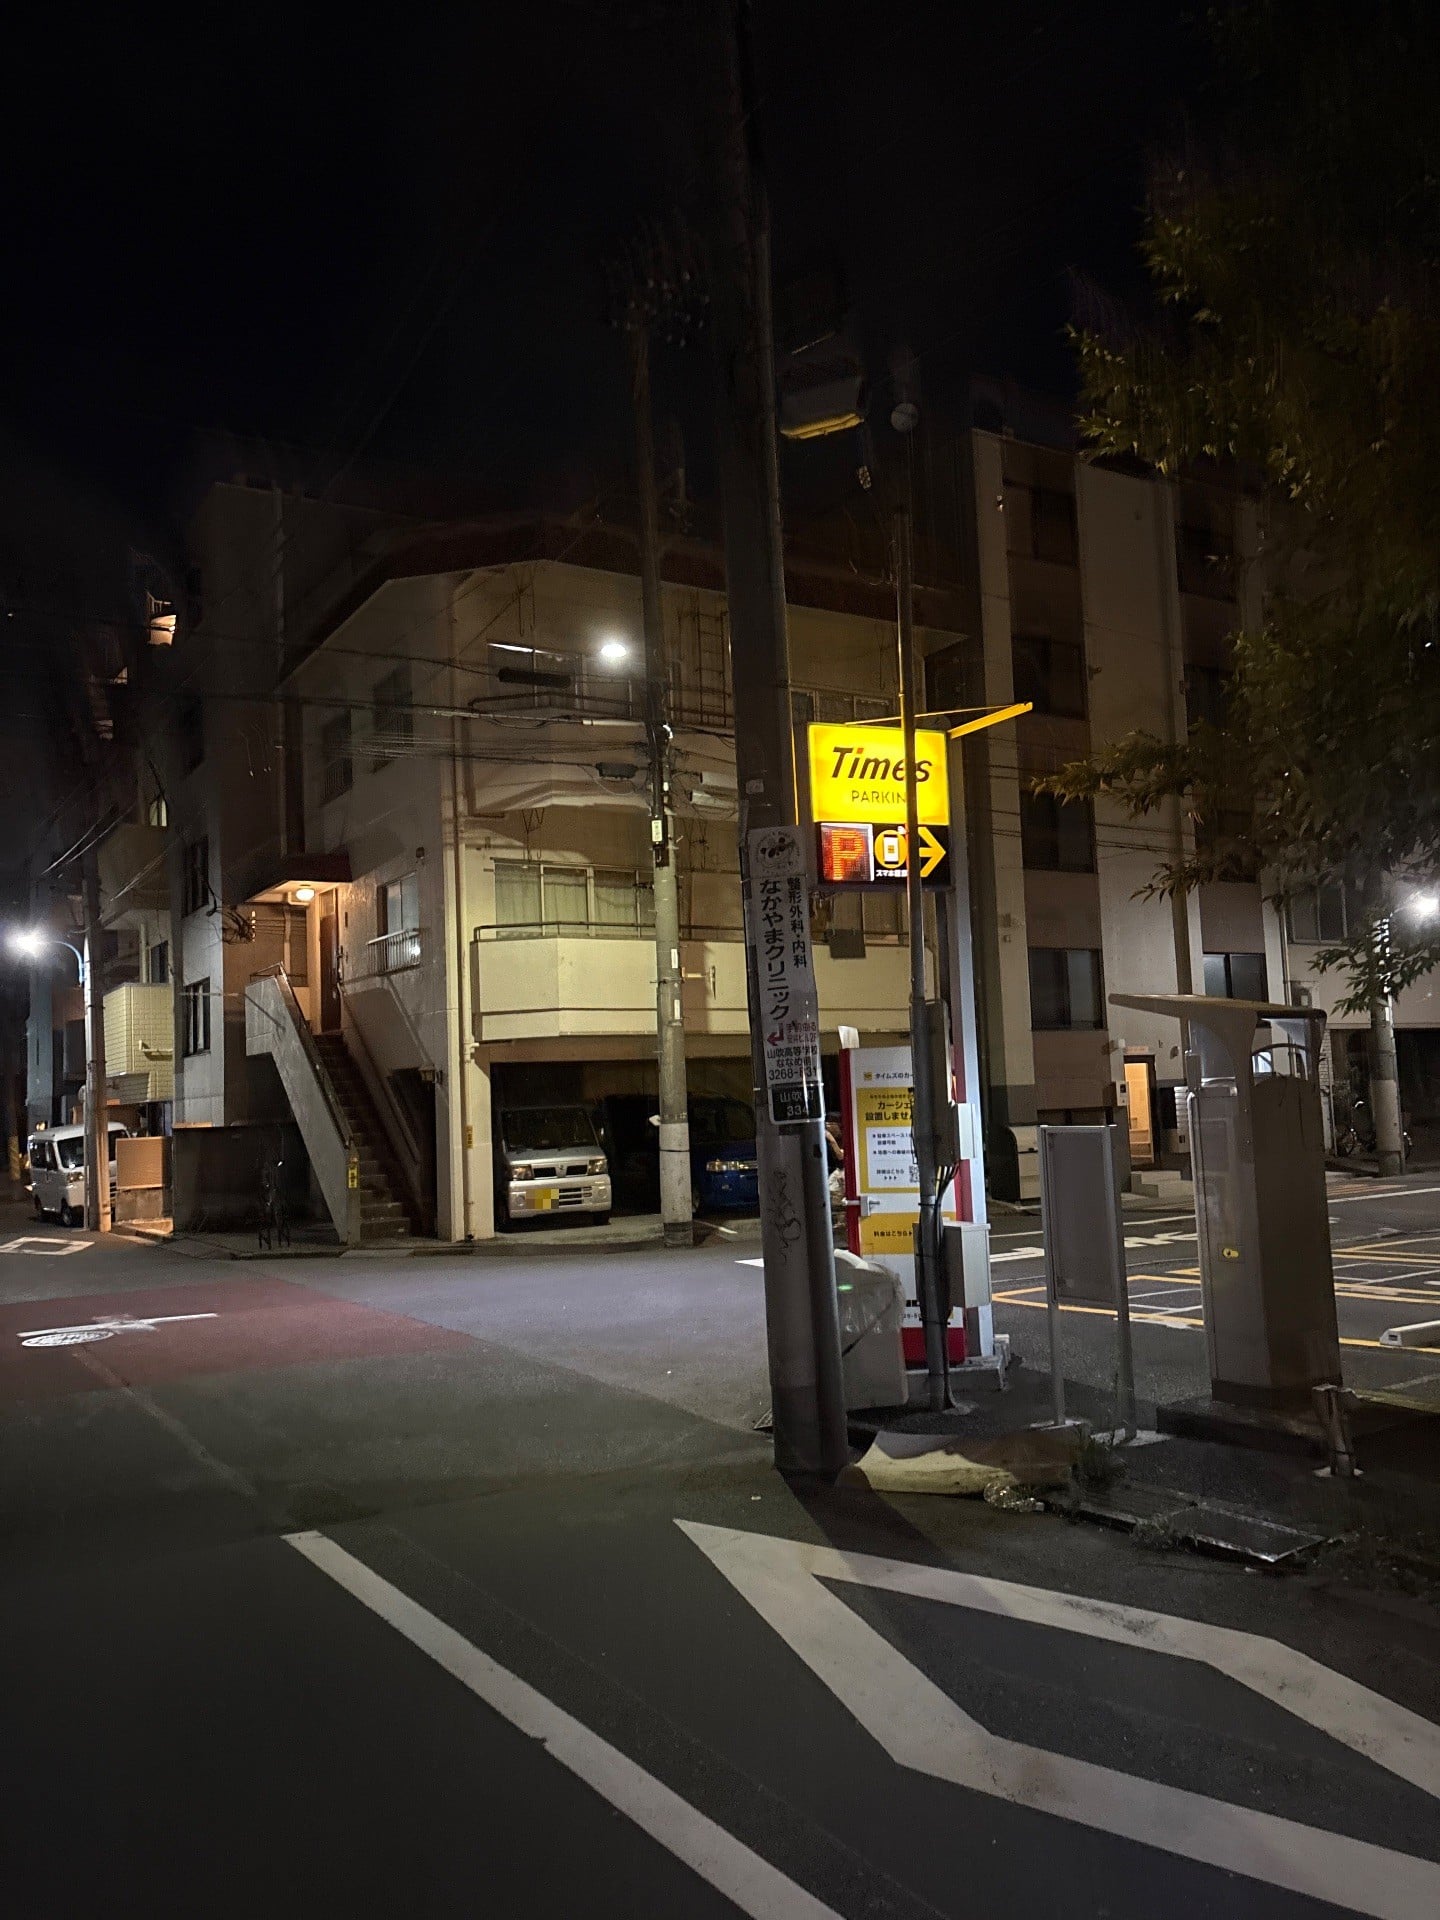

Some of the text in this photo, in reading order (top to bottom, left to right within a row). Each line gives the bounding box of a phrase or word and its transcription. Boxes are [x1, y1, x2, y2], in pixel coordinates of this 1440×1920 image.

[831, 746, 932, 783] Times
[851, 790, 907, 804] PARKIN
[832, 829, 865, 881] P
[760, 880, 790, 1021] なかやまクリニック
[878, 1101, 911, 1110] カーシェ
